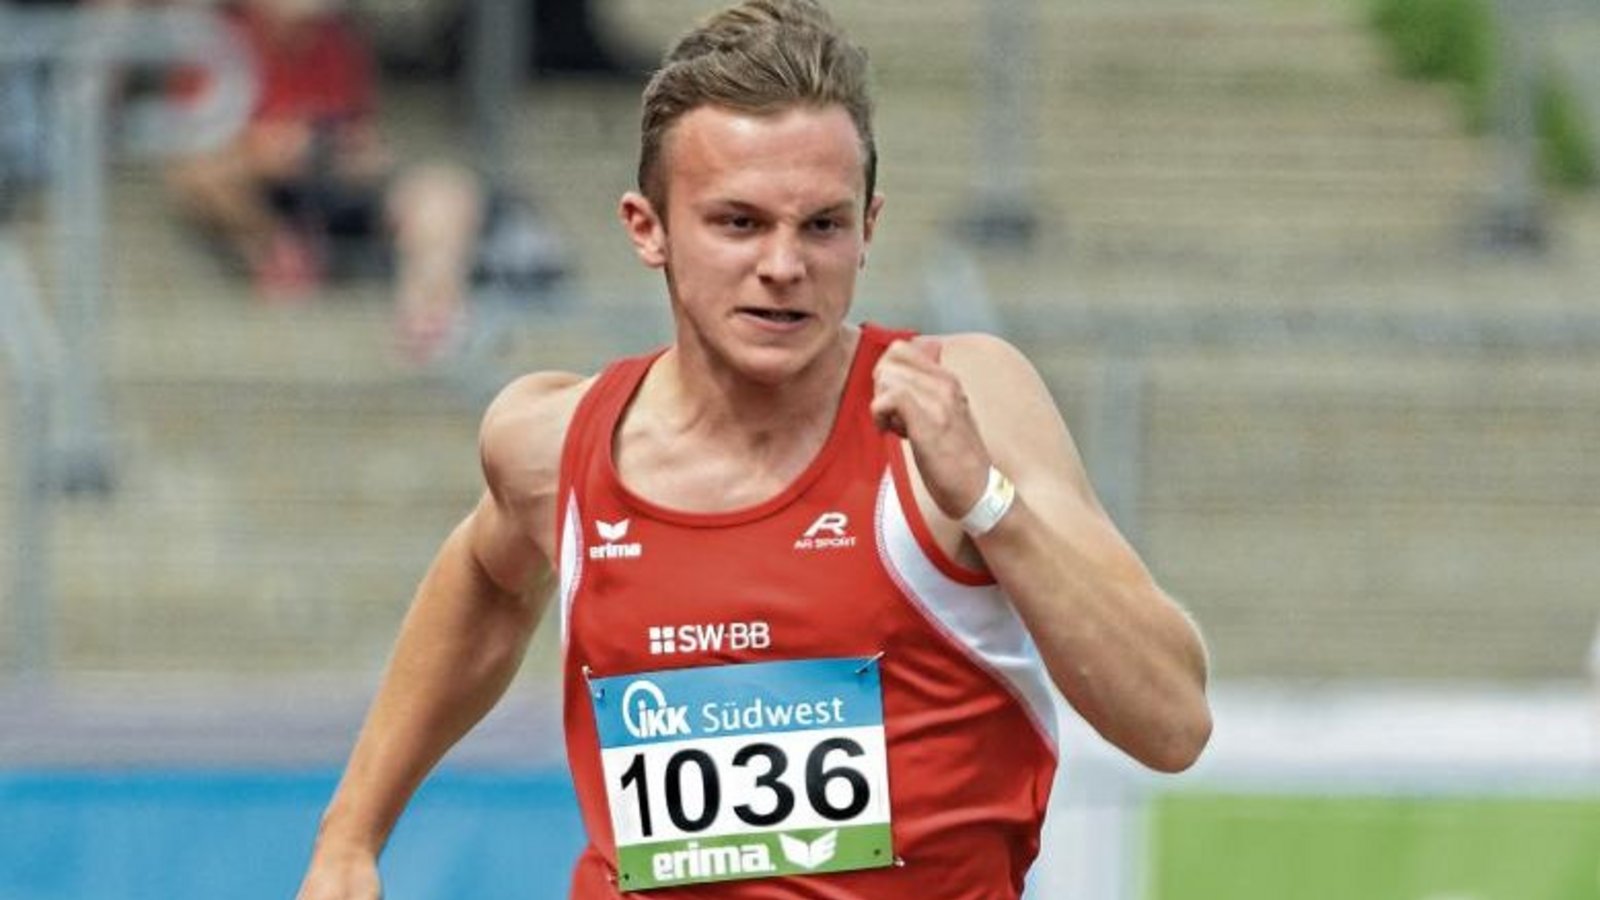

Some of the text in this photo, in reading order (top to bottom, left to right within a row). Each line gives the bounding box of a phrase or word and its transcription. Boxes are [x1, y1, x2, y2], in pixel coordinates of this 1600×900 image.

[589, 542, 642, 559] erima
[815, 536, 857, 549] SPORT
[702, 697, 844, 733] Südwest
[620, 737, 871, 837] 1036
